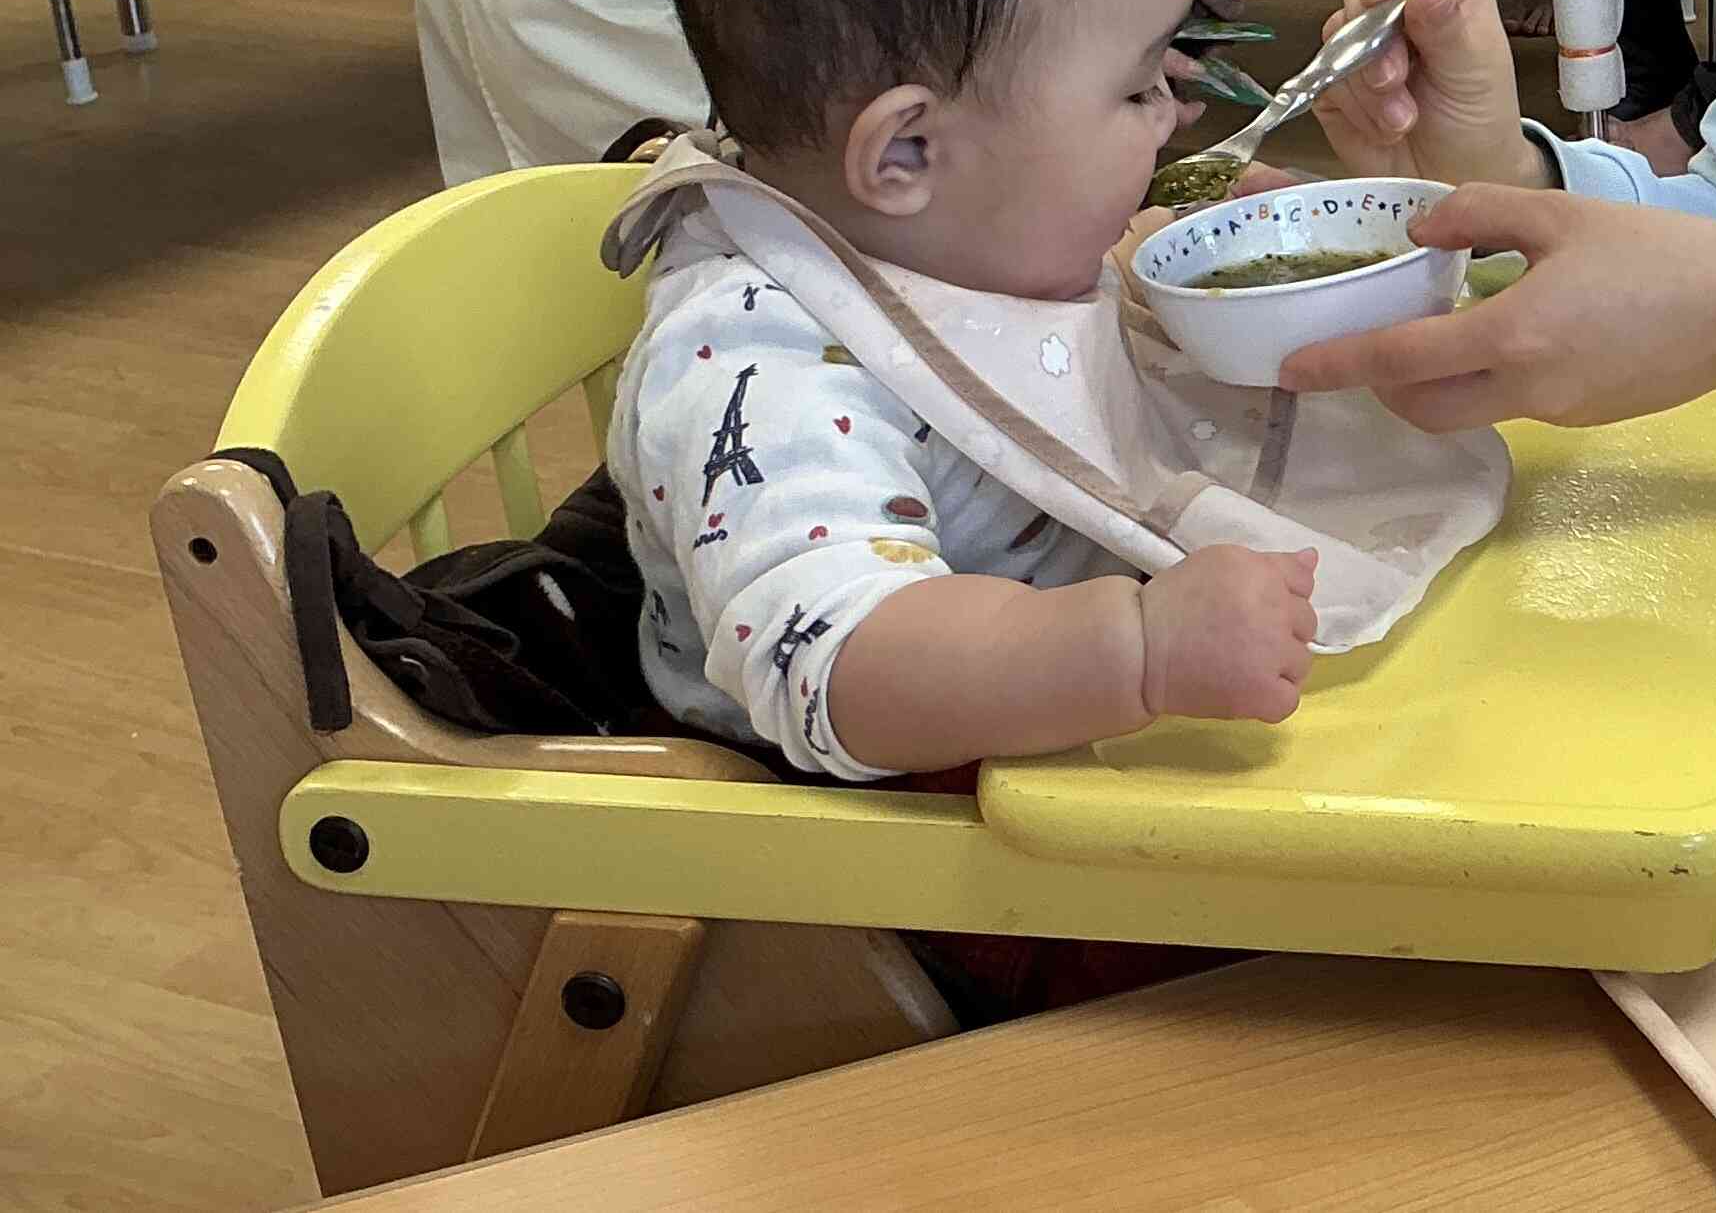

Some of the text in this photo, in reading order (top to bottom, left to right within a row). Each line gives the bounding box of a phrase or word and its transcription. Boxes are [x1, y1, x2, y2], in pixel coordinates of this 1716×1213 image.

[1187, 227, 1202, 246] Z
[1228, 219, 1241, 237] A
[1258, 204, 1270, 219] B
[1289, 207, 1301, 223] C
[1323, 199, 1339, 215] D
[1361, 193, 1375, 211] E
[1391, 203, 1402, 221] F
